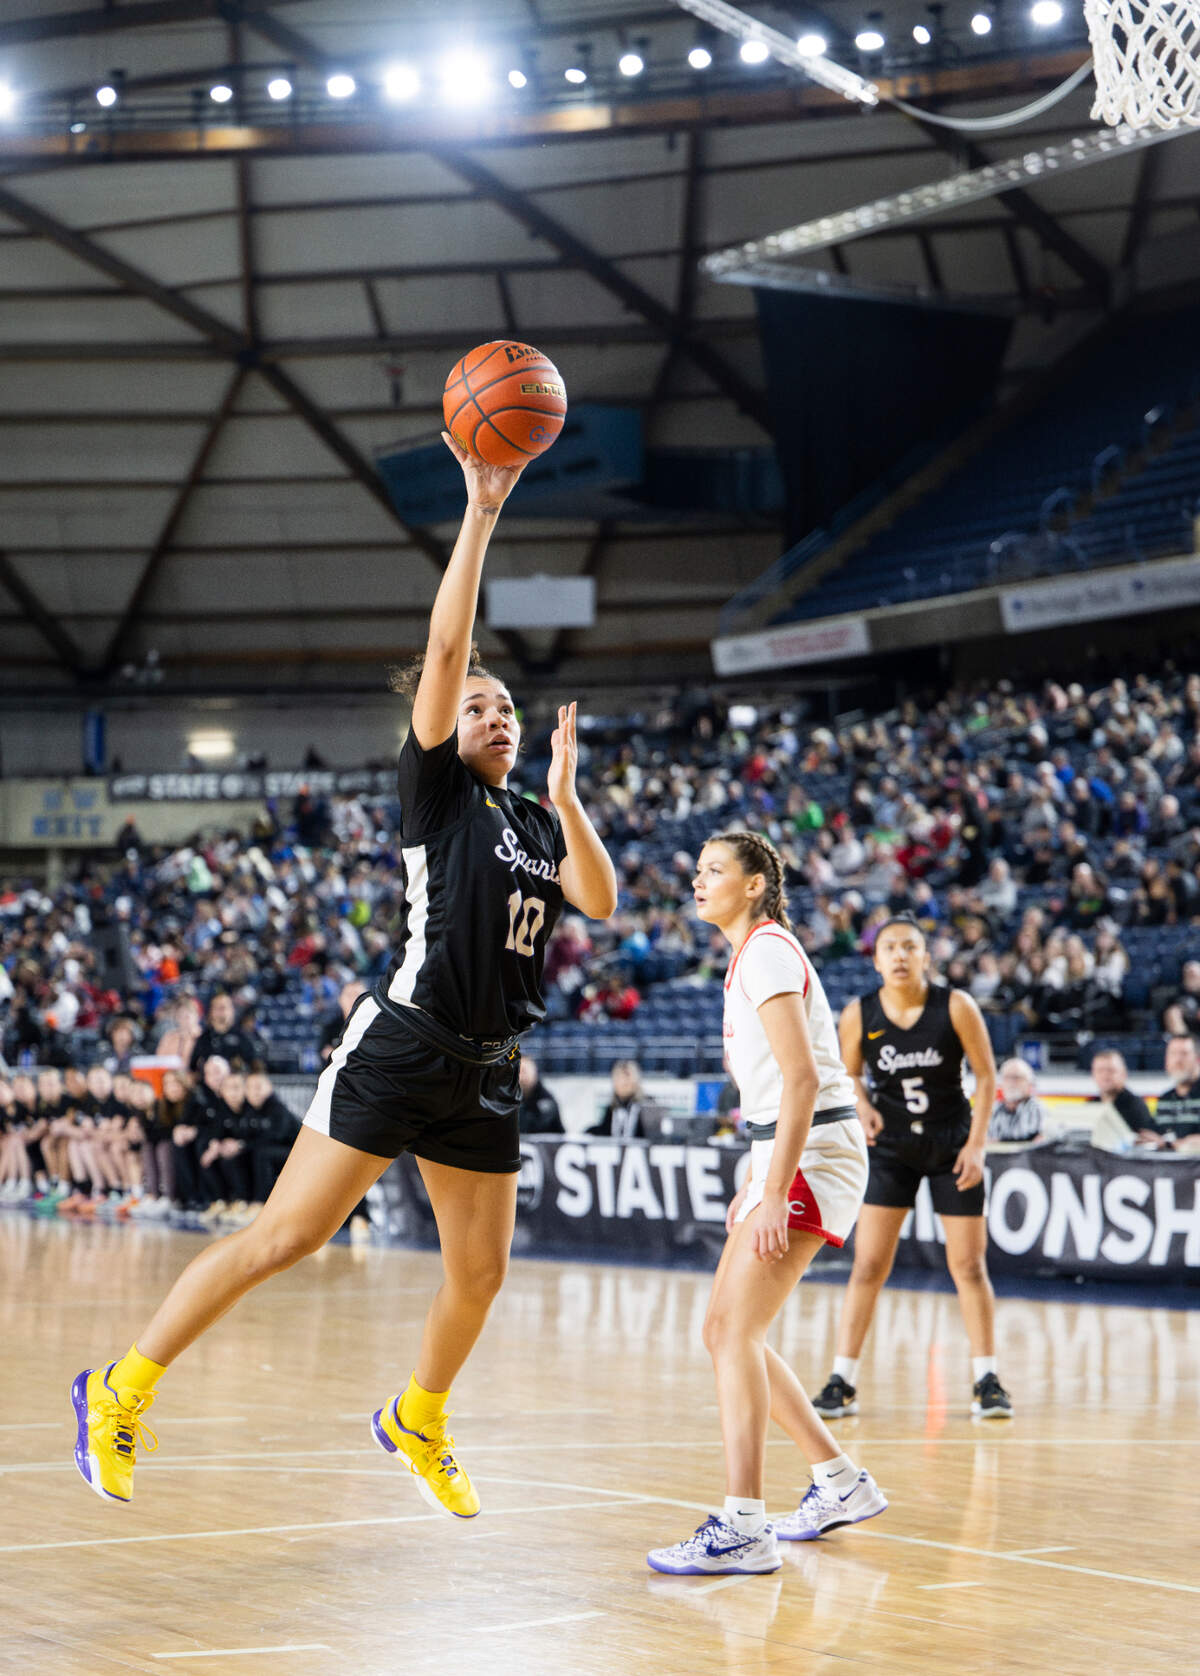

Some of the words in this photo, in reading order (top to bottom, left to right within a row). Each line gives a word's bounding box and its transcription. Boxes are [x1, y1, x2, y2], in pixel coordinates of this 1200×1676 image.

[505, 889, 545, 958] 10
[901, 1076, 929, 1114] 5
[553, 1143, 730, 1222] STATE
